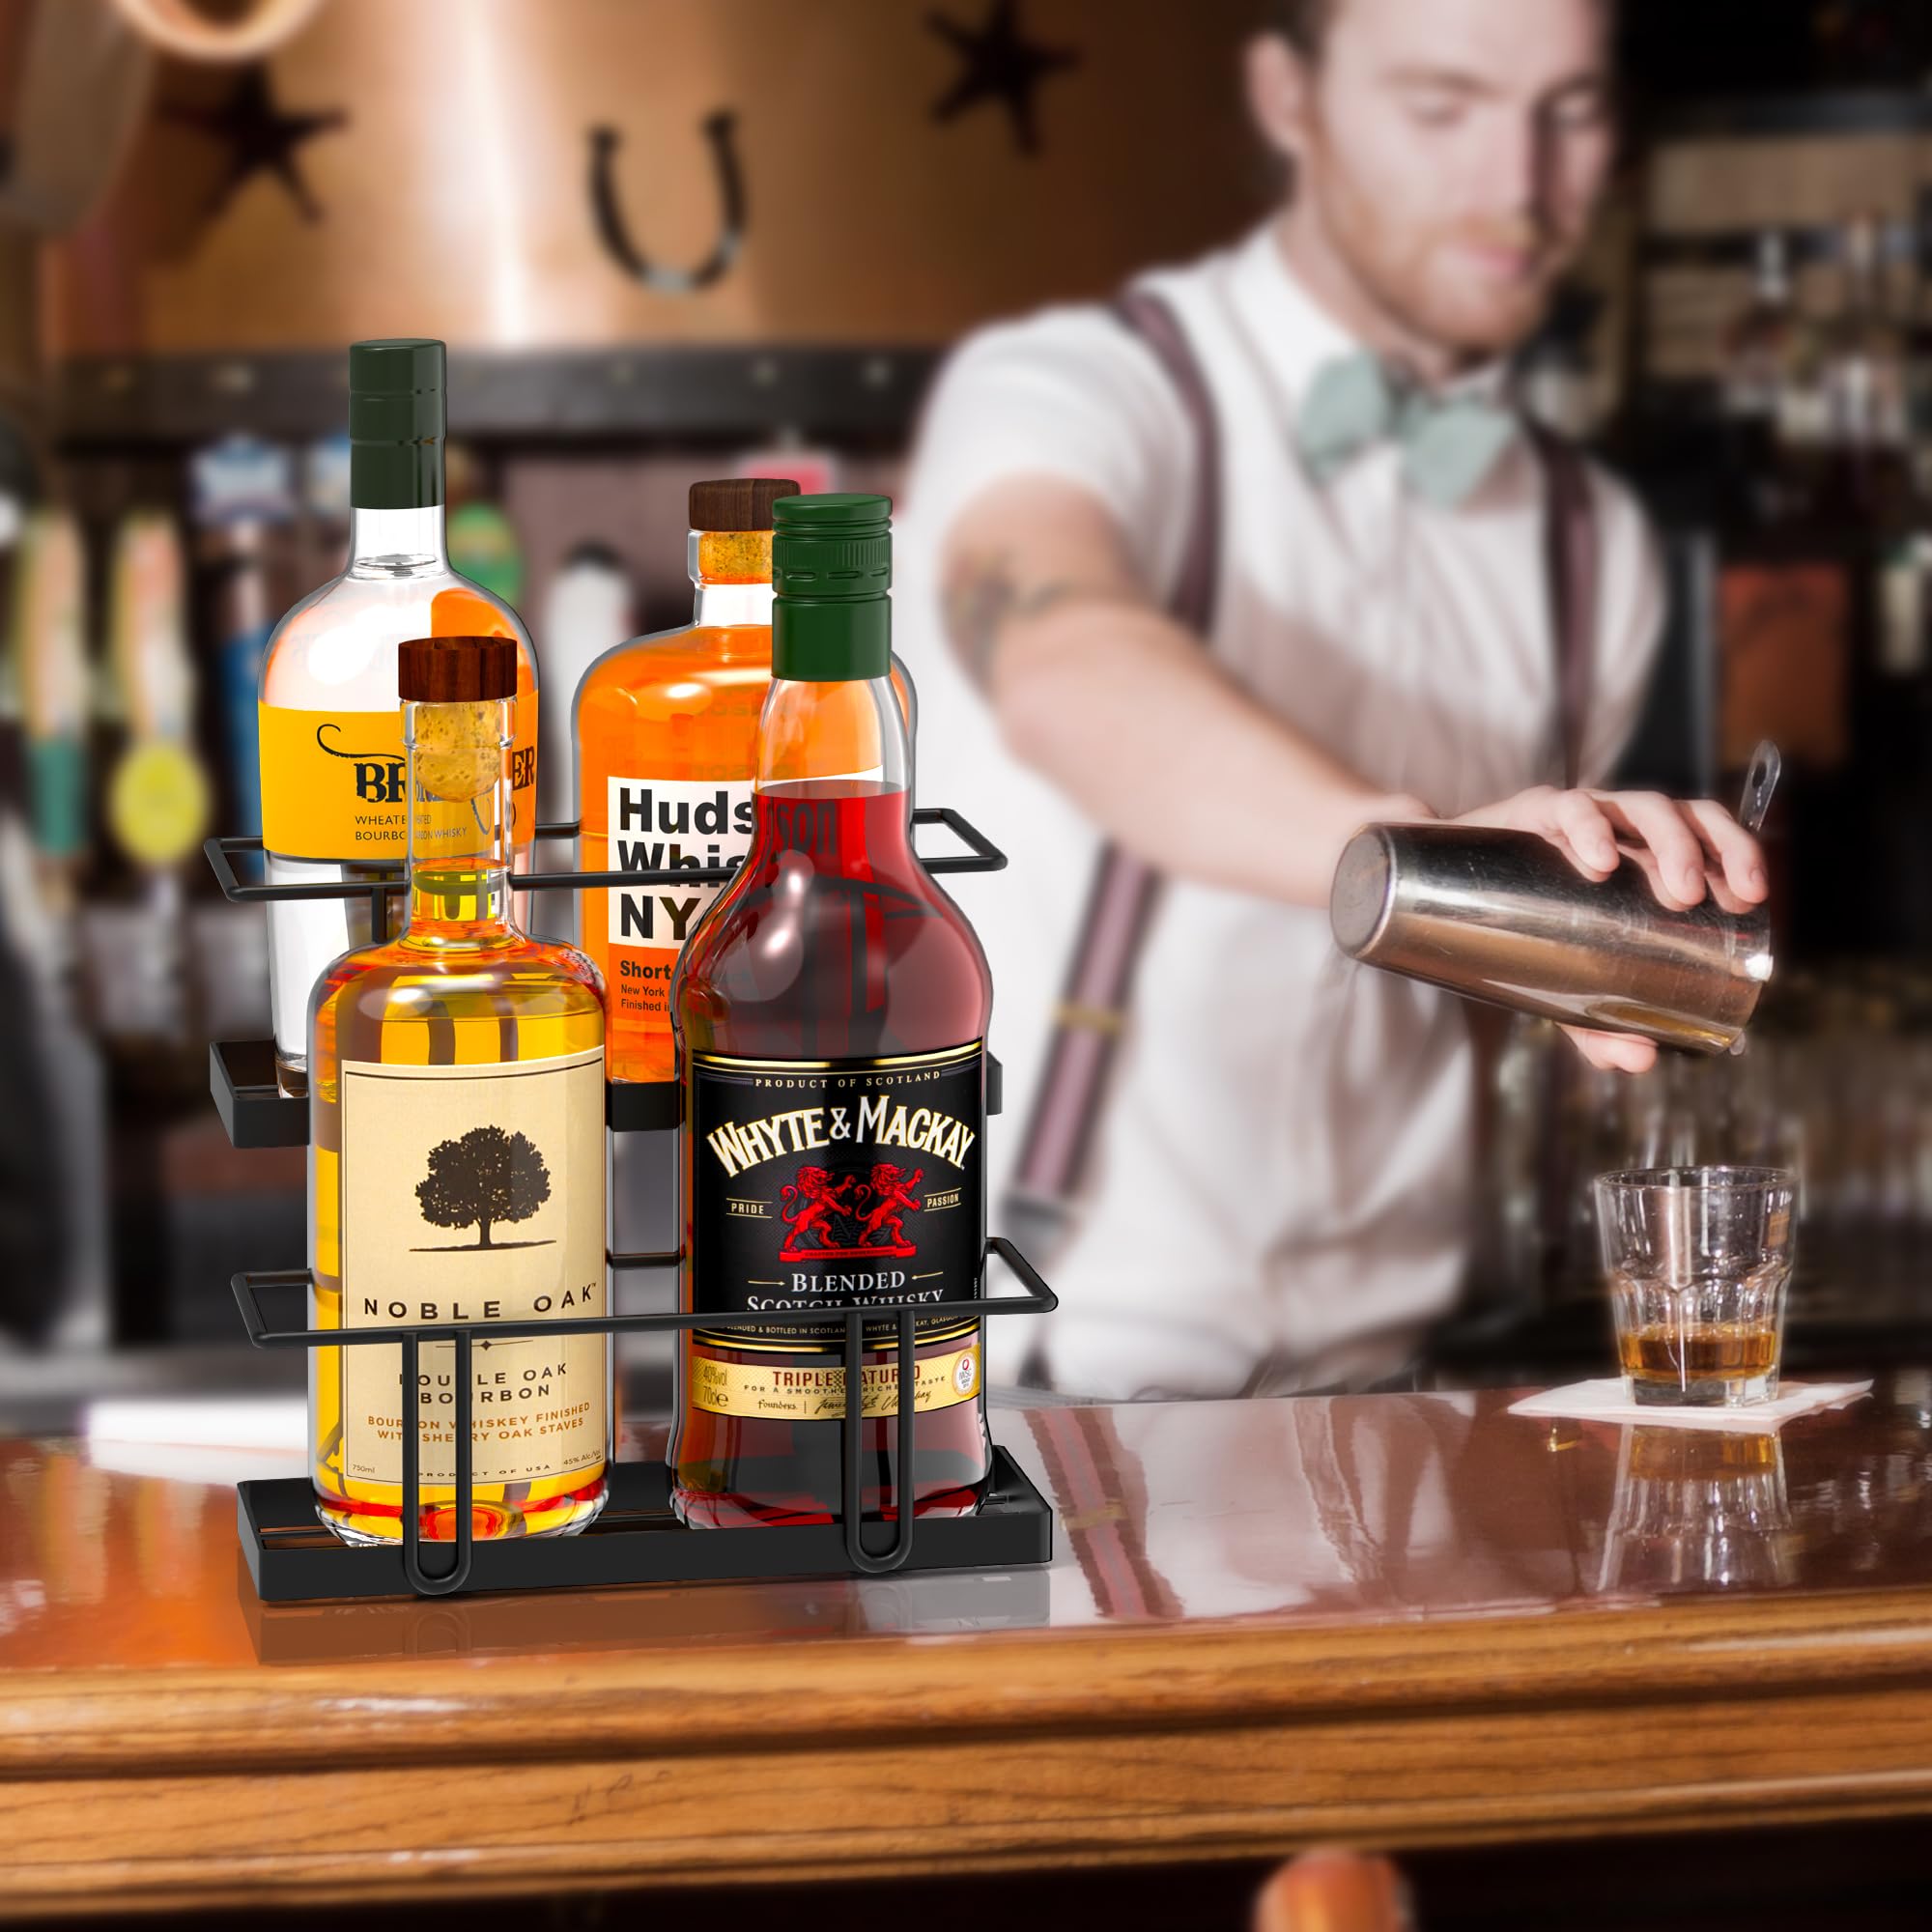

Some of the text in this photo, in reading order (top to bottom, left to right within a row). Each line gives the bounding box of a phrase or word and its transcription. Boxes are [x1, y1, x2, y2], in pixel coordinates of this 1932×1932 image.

[435, 827, 468, 840] WHISKY
[620, 959, 671, 980] Short
[621, 983, 665, 998] New York
[621, 998, 661, 1011] Finished
[755, 1070, 940, 1089] PRODUCT OF SCOTLAND
[706, 1094, 976, 1178] WHYTE & MACKAY
[731, 1203, 764, 1215] PRIDE
[927, 1194, 959, 1208] PASSION
[791, 1270, 905, 1293] BLENDED
[364, 1297, 500, 1321] NOBLE
[866, 1322, 889, 1332] WHYTE
[399, 1363, 566, 1387] OULE OAK
[774, 1371, 833, 1387] TRIPLE
[915, 1376, 946, 1386] TASTE
[420, 1384, 549, 1405] BORBON
[368, 1415, 440, 1430] BOURON
[536, 1402, 590, 1423] FINISHED
[378, 1417, 583, 1442] WIT SHERY OAK STAVES
[352, 1463, 376, 1474] 750ml
[526, 1463, 551, 1473] USA
